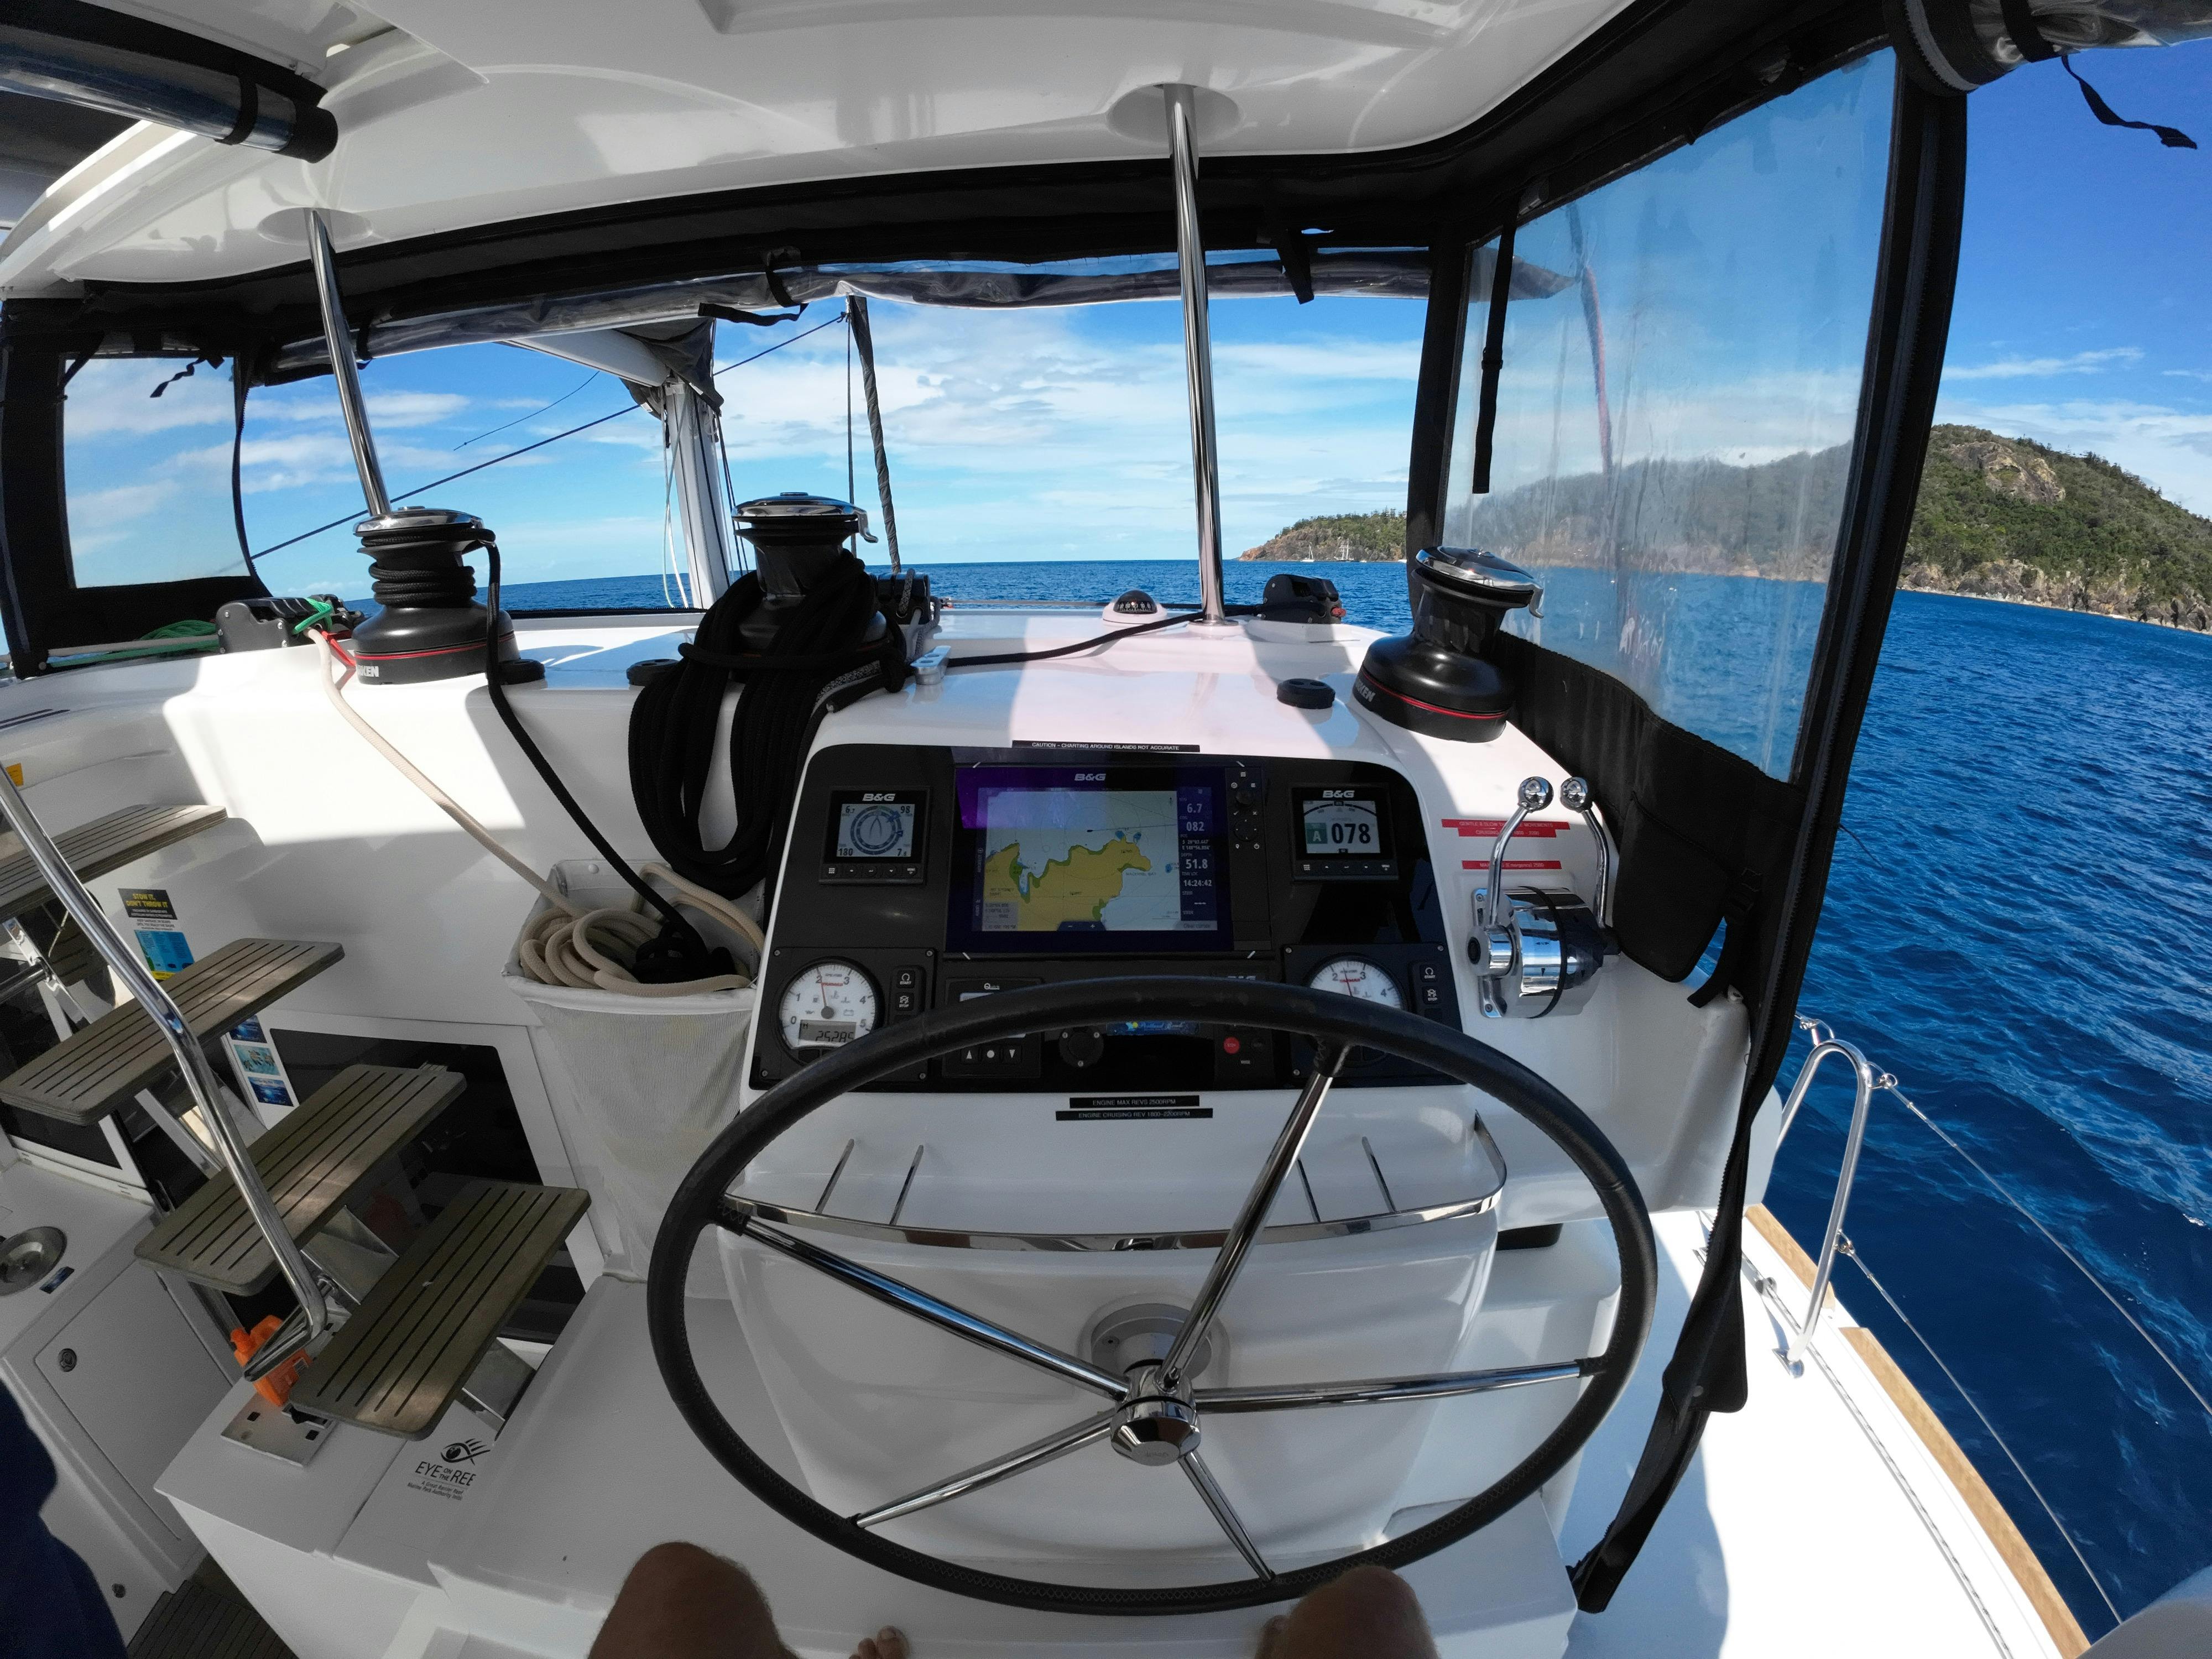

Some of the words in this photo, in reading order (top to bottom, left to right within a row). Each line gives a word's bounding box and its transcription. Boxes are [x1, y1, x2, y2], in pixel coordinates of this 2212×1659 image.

[862, 793, 896, 801] B&G
[1322, 790, 1355, 798] B&G
[1187, 803, 1203, 813] 6.7
[1186, 821, 1205, 832] 082
[1313, 831, 1322, 842] A
[1332, 823, 1371, 844] 078
[1186, 859, 1208, 869] 51.8
[843, 976, 850, 985] 3
[1332, 973, 1338, 981] 2
[796, 993, 801, 1001] 1
[1381, 988, 1387, 997] 4
[859, 995, 866, 1004] 4
[790, 1016, 796, 1024] 0
[859, 1019, 867, 1028] 5
[415, 1461, 443, 1478] EYE
[432, 1489, 451, 1499] Authority
